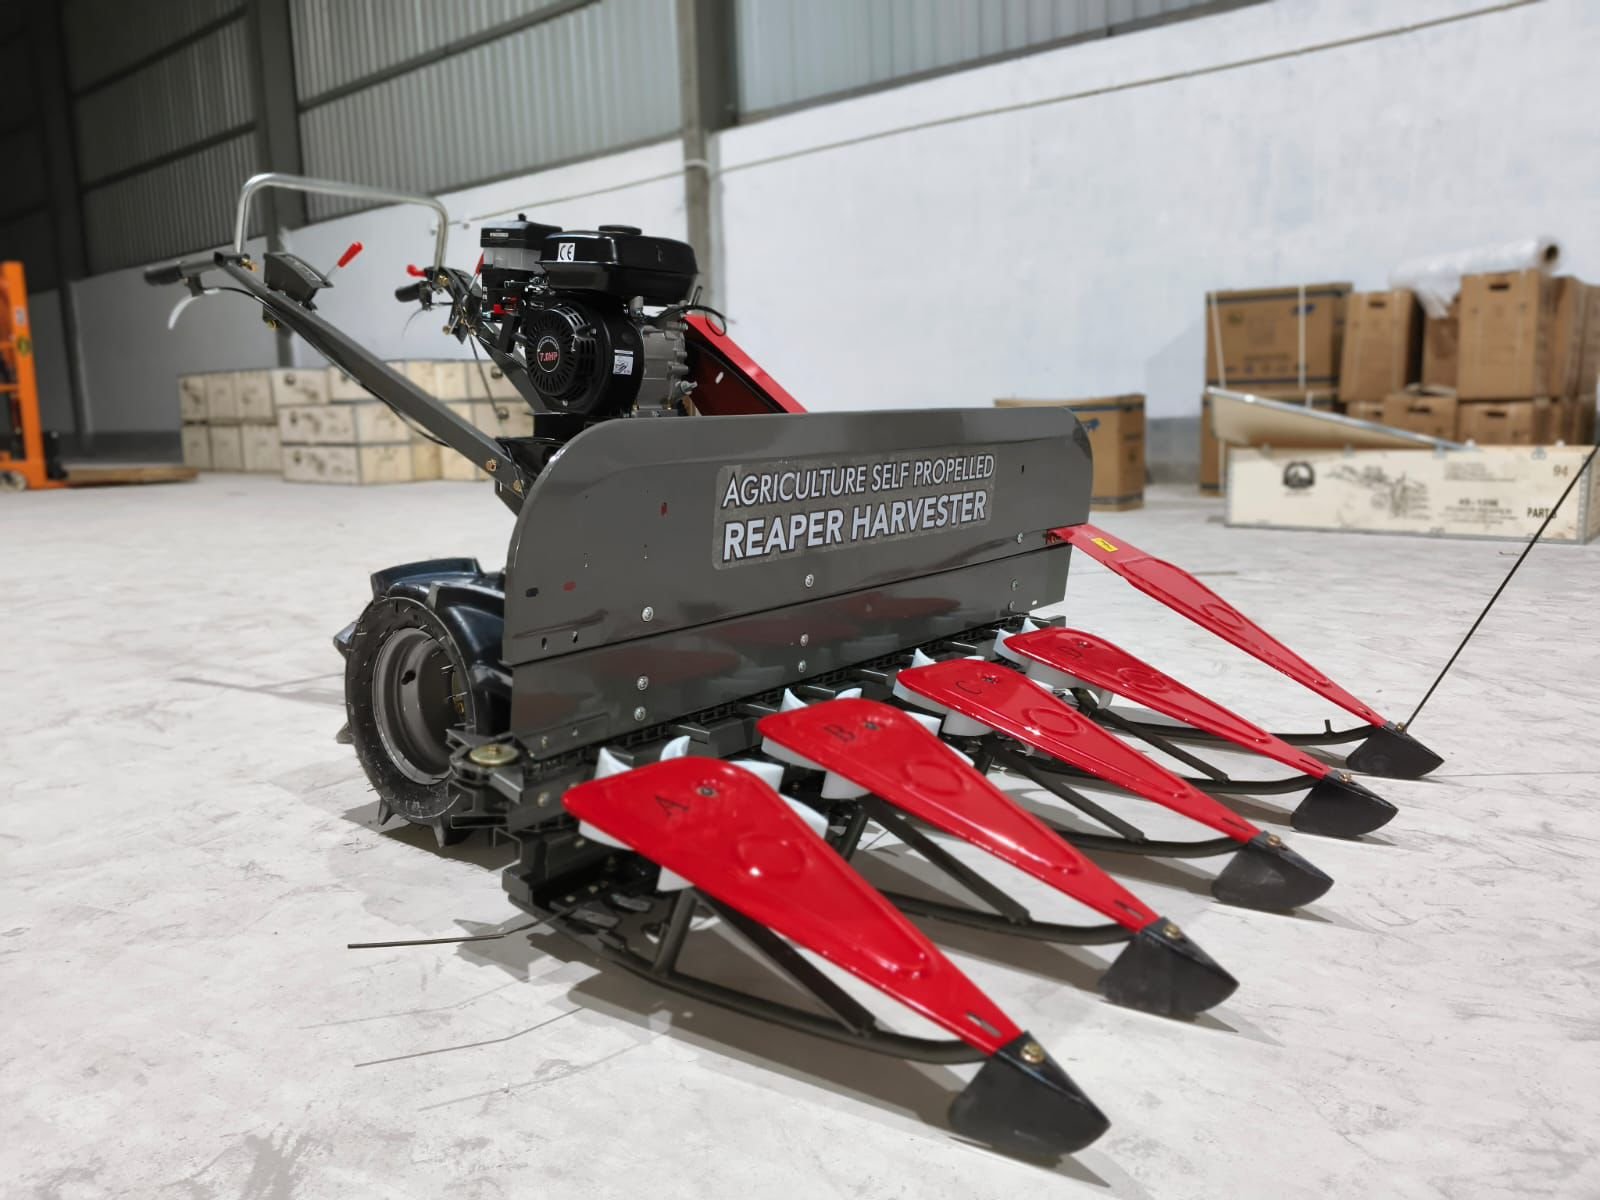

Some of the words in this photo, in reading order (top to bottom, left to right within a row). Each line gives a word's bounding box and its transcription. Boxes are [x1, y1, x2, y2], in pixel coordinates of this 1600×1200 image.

[722, 467, 867, 508] AGRICULTURE
[871, 463, 909, 491] SELF
[914, 455, 994, 486] PROPELLED
[723, 509, 844, 561] REAPER
[851, 490, 987, 540] HARVESTER
[824, 725, 856, 743] B
[654, 795, 689, 817] A
